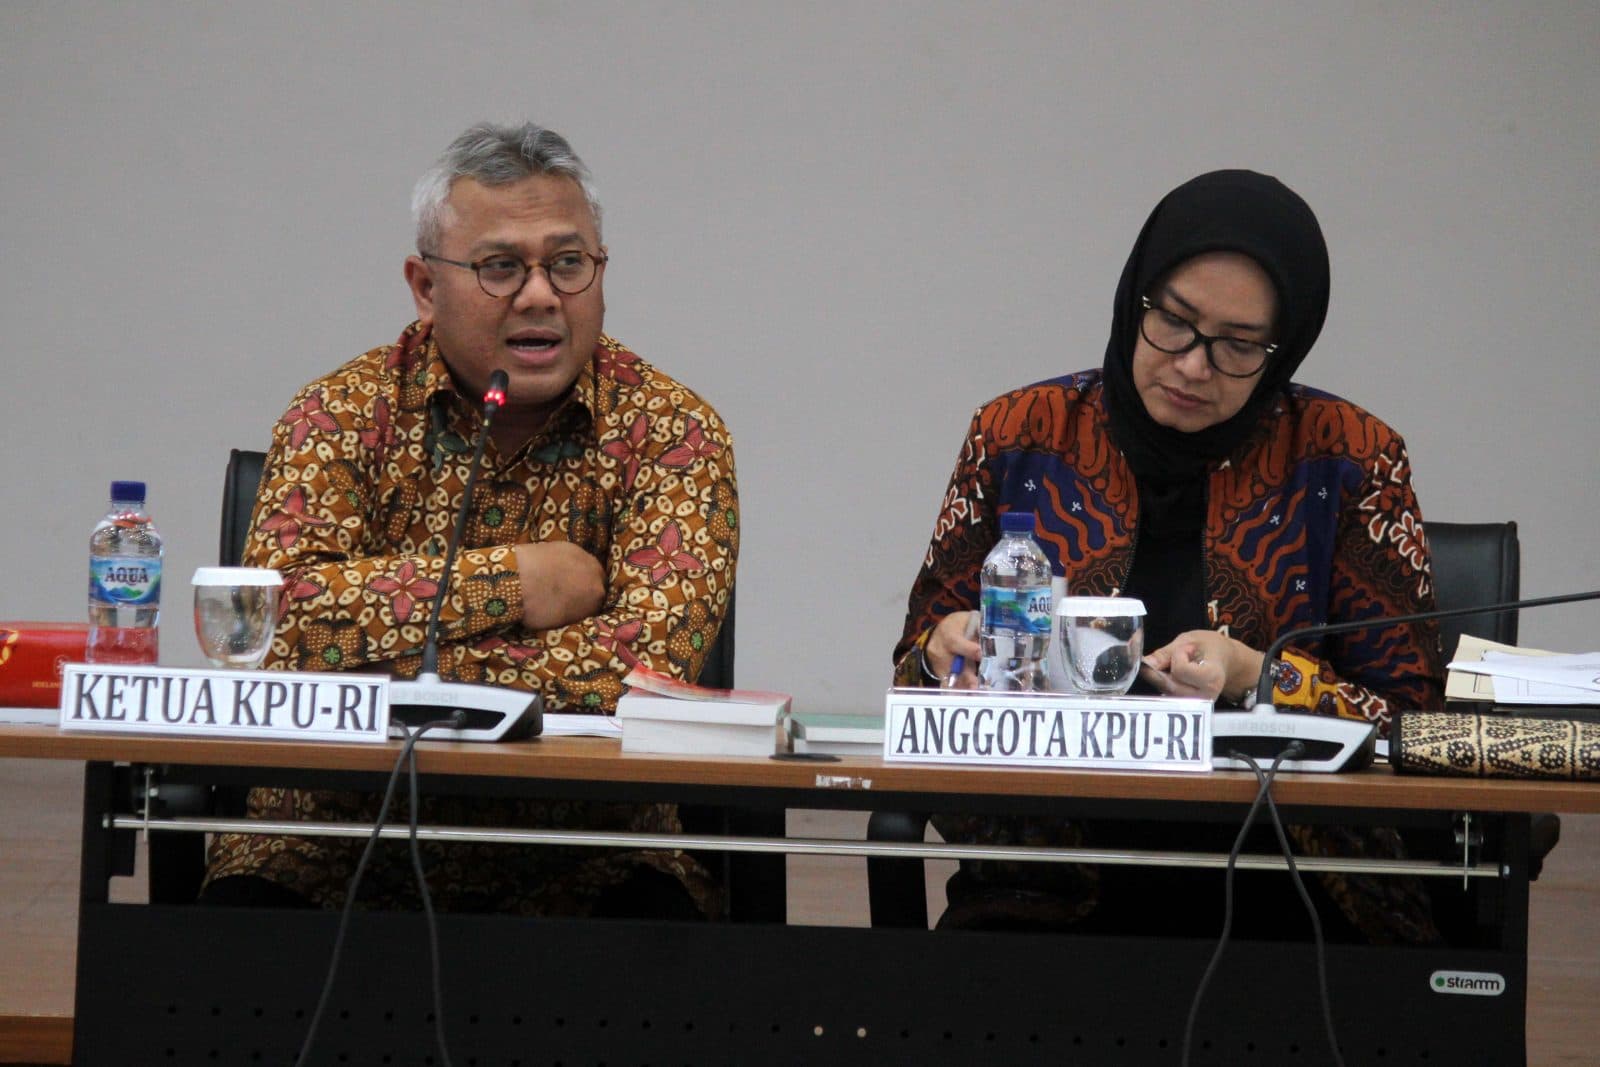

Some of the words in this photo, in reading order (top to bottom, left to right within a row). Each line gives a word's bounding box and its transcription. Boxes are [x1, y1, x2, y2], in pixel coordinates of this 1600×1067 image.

[104, 567, 149, 586] AQUA
[72, 673, 216, 725] KETUA
[229, 680, 380, 732] KPU-RI
[896, 707, 1069, 757] ANGGOTA
[1079, 711, 1203, 761] KPU-RI
[1250, 721, 1296, 735] BOSCH
[1447, 976, 1500, 991] stramm
